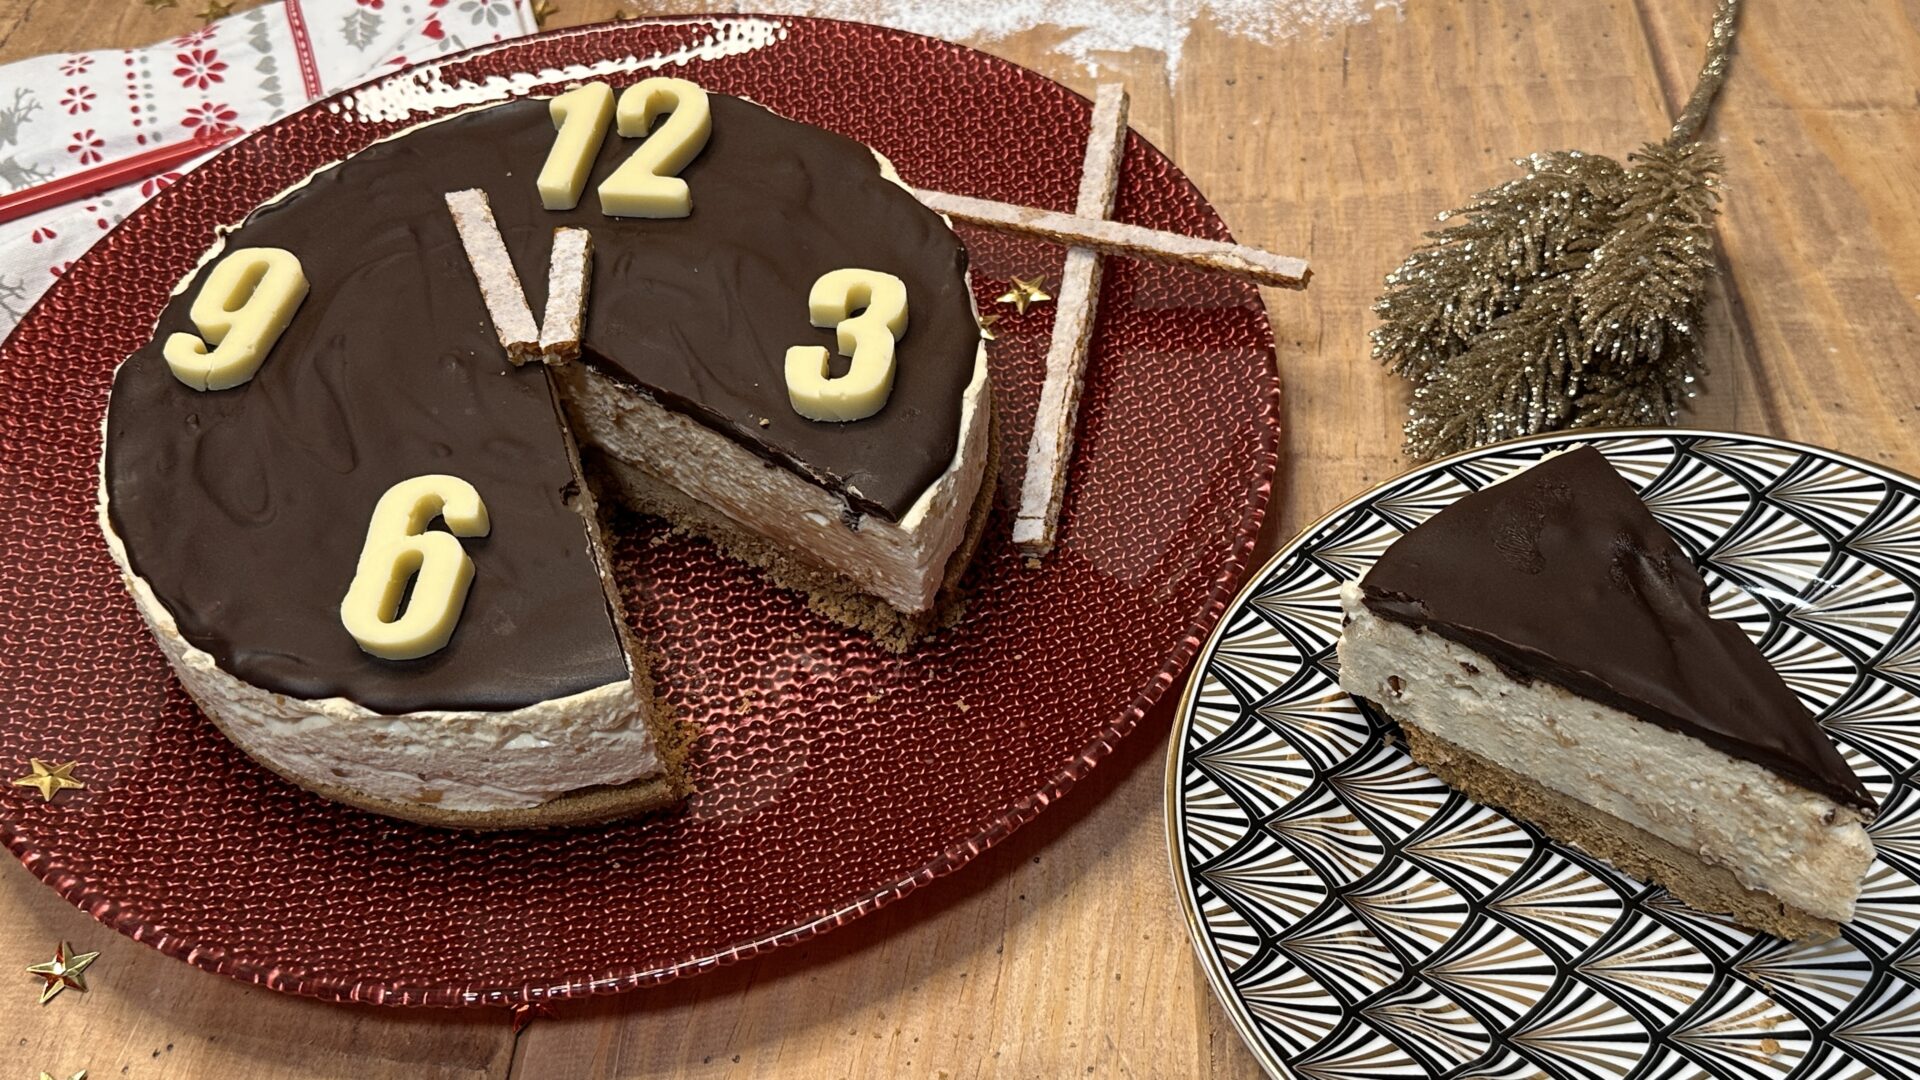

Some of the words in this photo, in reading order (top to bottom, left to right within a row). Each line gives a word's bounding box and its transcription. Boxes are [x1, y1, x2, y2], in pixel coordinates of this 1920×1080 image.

[537, 77, 712, 219] 12
[163, 247, 310, 392] 9
[785, 268, 908, 422] 3
[340, 474, 490, 660] 6
